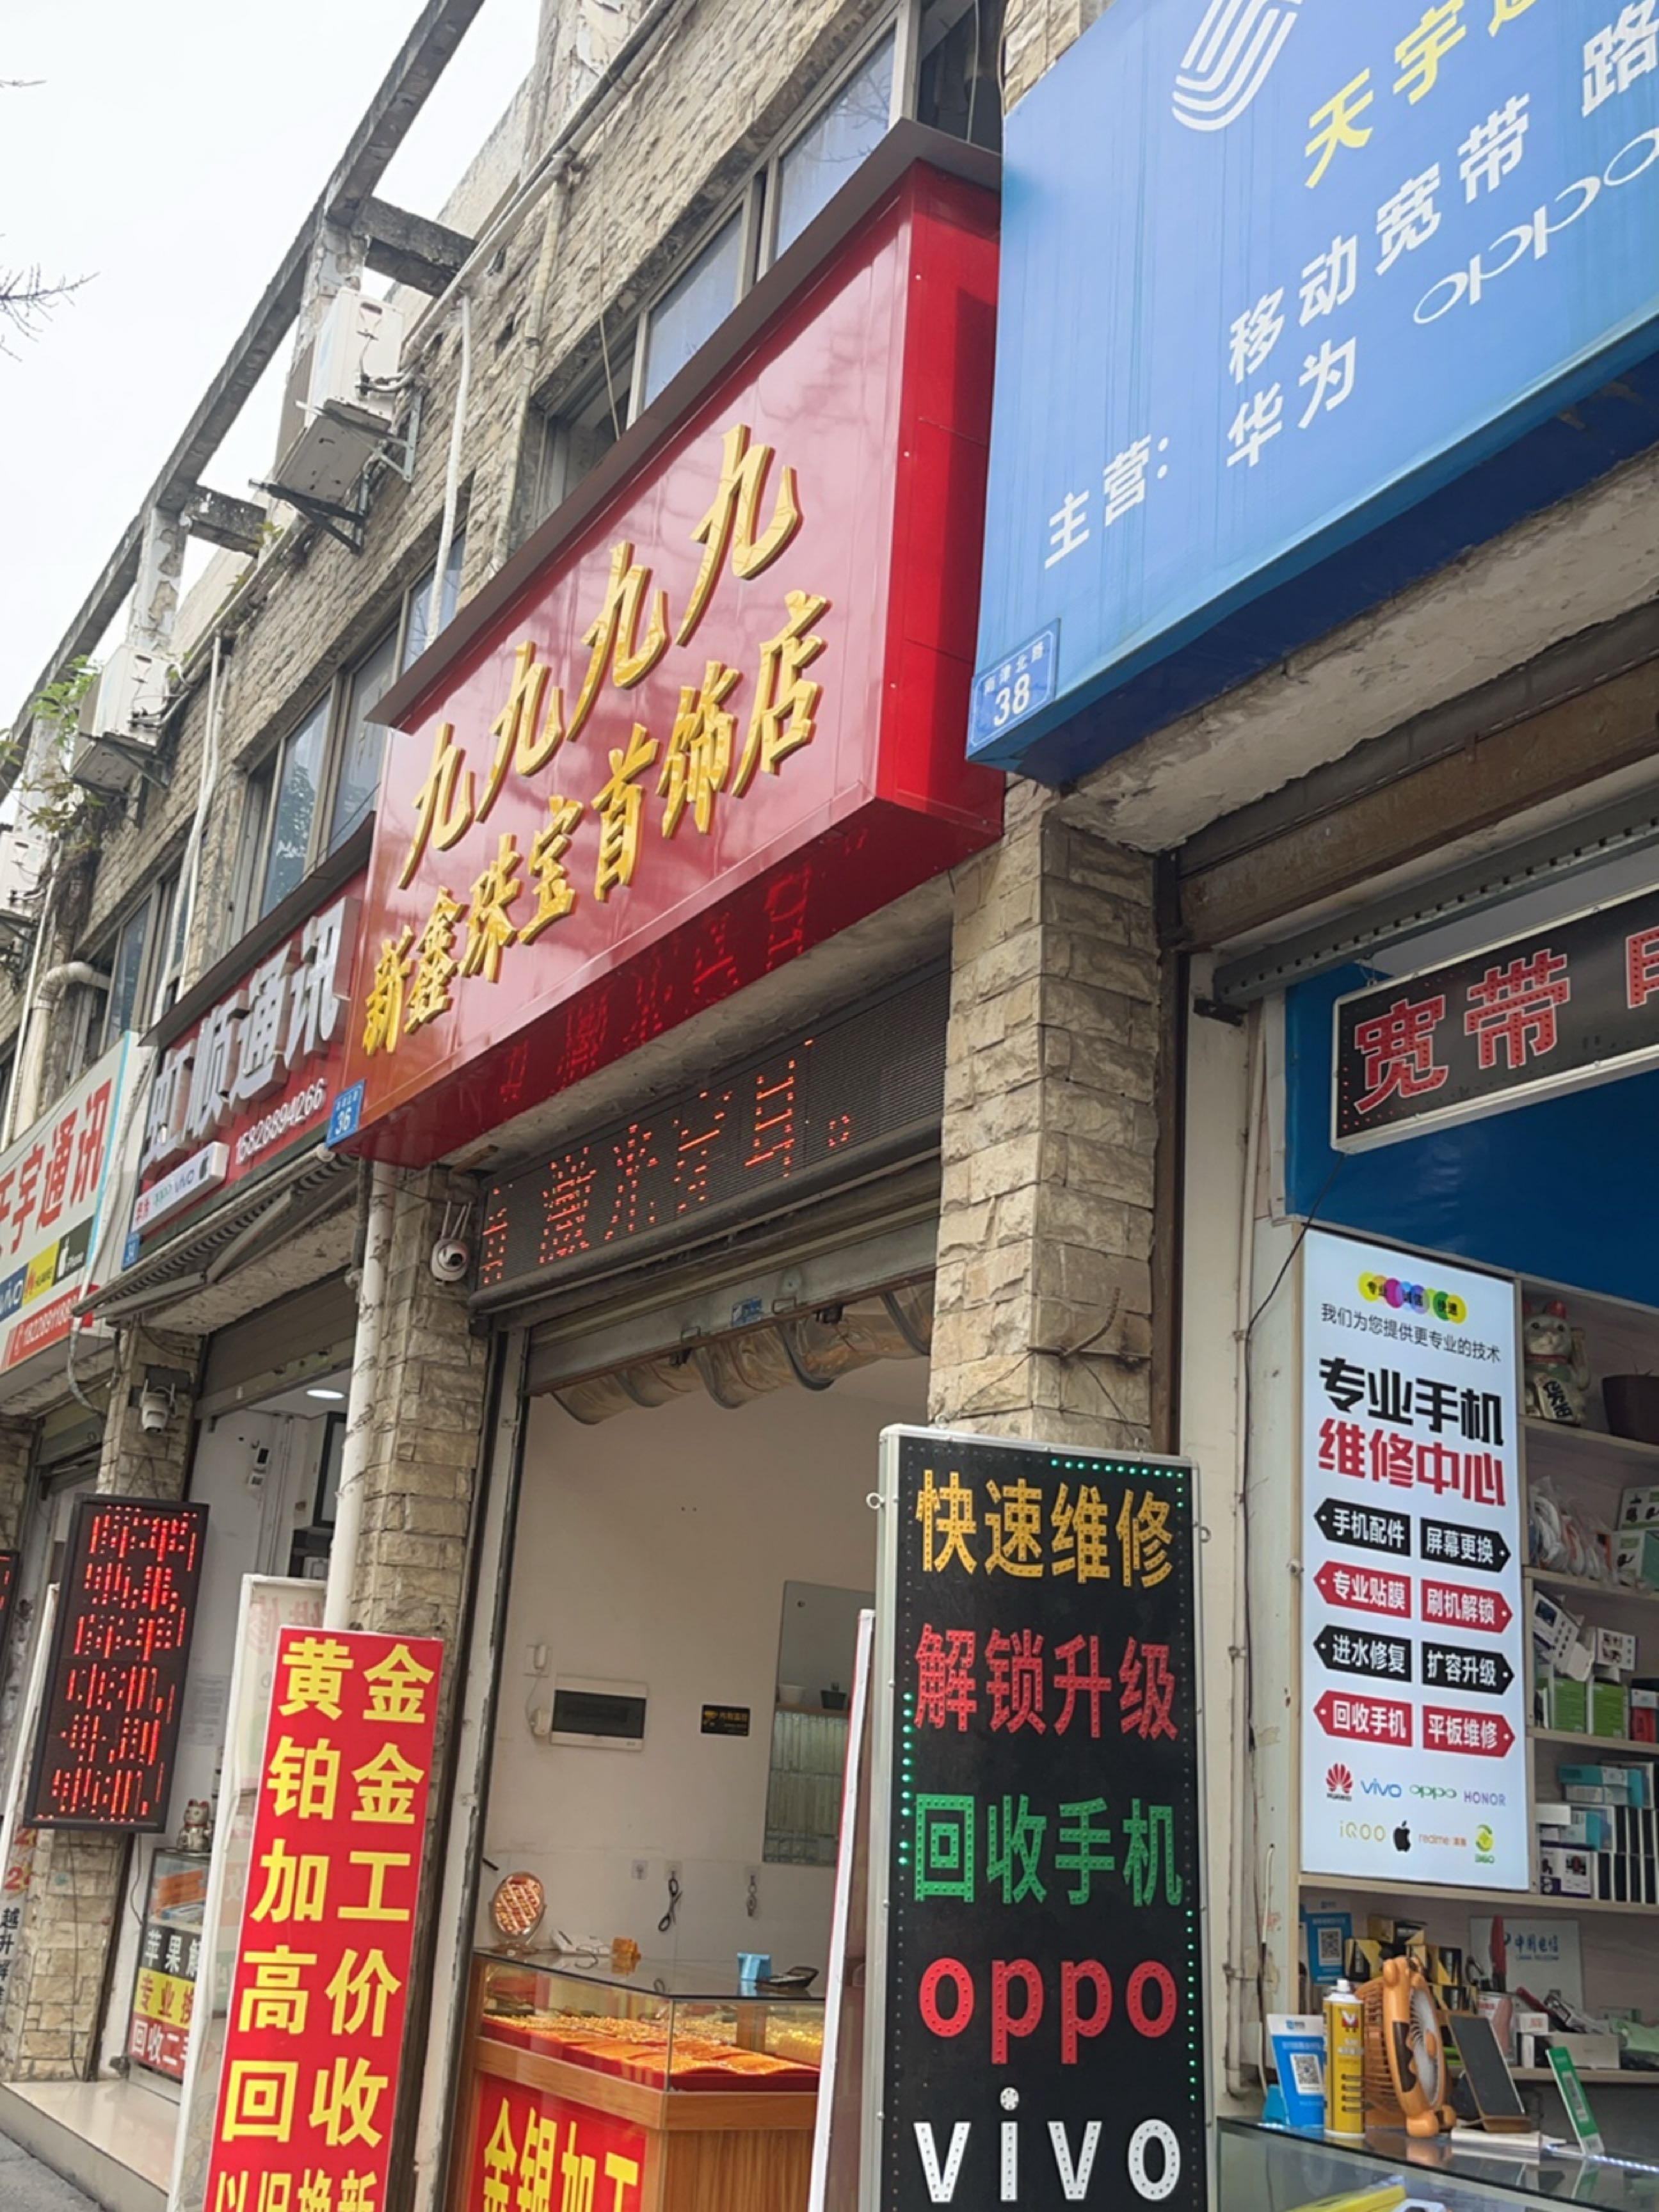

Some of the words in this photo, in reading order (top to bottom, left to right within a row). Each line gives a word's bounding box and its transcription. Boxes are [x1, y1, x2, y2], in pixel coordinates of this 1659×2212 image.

[1304, 0, 1537, 188] 天宇
[1228, 93, 1530, 385] 移动宽带
[1226, 337, 1357, 467] 华为
[398, 423, 803, 890] 九九九九
[994, 673, 1030, 726] 38
[361, 589, 831, 1055] 新鑫珠宝首饰店
[1354, 949, 1571, 1114] 宽带
[334, 1107, 352, 1135] 36
[1321, 1302, 1502, 1363] 我们为您提供更专业的技术
[1319, 1356, 1504, 1447] 专业手机
[1318, 1417, 1506, 1507] 维修中心
[915, 1468, 1174, 1589] 快速维修
[1333, 1508, 1406, 1549] 手机配件
[1426, 1527, 1495, 1564] 屏幕更换
[1333, 1571, 1406, 1610] 专业贴膜
[1427, 1588, 1496, 1624] 刷机解锁
[278, 1637, 435, 1723] 黄金
[914, 1623, 1178, 1741] 解锁升级
[1333, 1633, 1406, 1675] 进水修复
[1427, 1649, 1497, 1687] 扩容升级
[1333, 1699, 1407, 1740] 回收手机
[1428, 1713, 1498, 1750] 平板维修
[267, 1735, 425, 1825] 铂金
[1360, 1777, 1402, 1799] vivo
[1464, 1790, 1507, 1807] HONOR
[250, 1838, 412, 1924] 加工
[913, 1793, 1182, 1907] 回收手机
[237, 1944, 401, 2039] 高价
[918, 1957, 1178, 2065] oppo
[221, 2056, 389, 2148] 回收
[914, 2085, 1182, 2203] vivo
